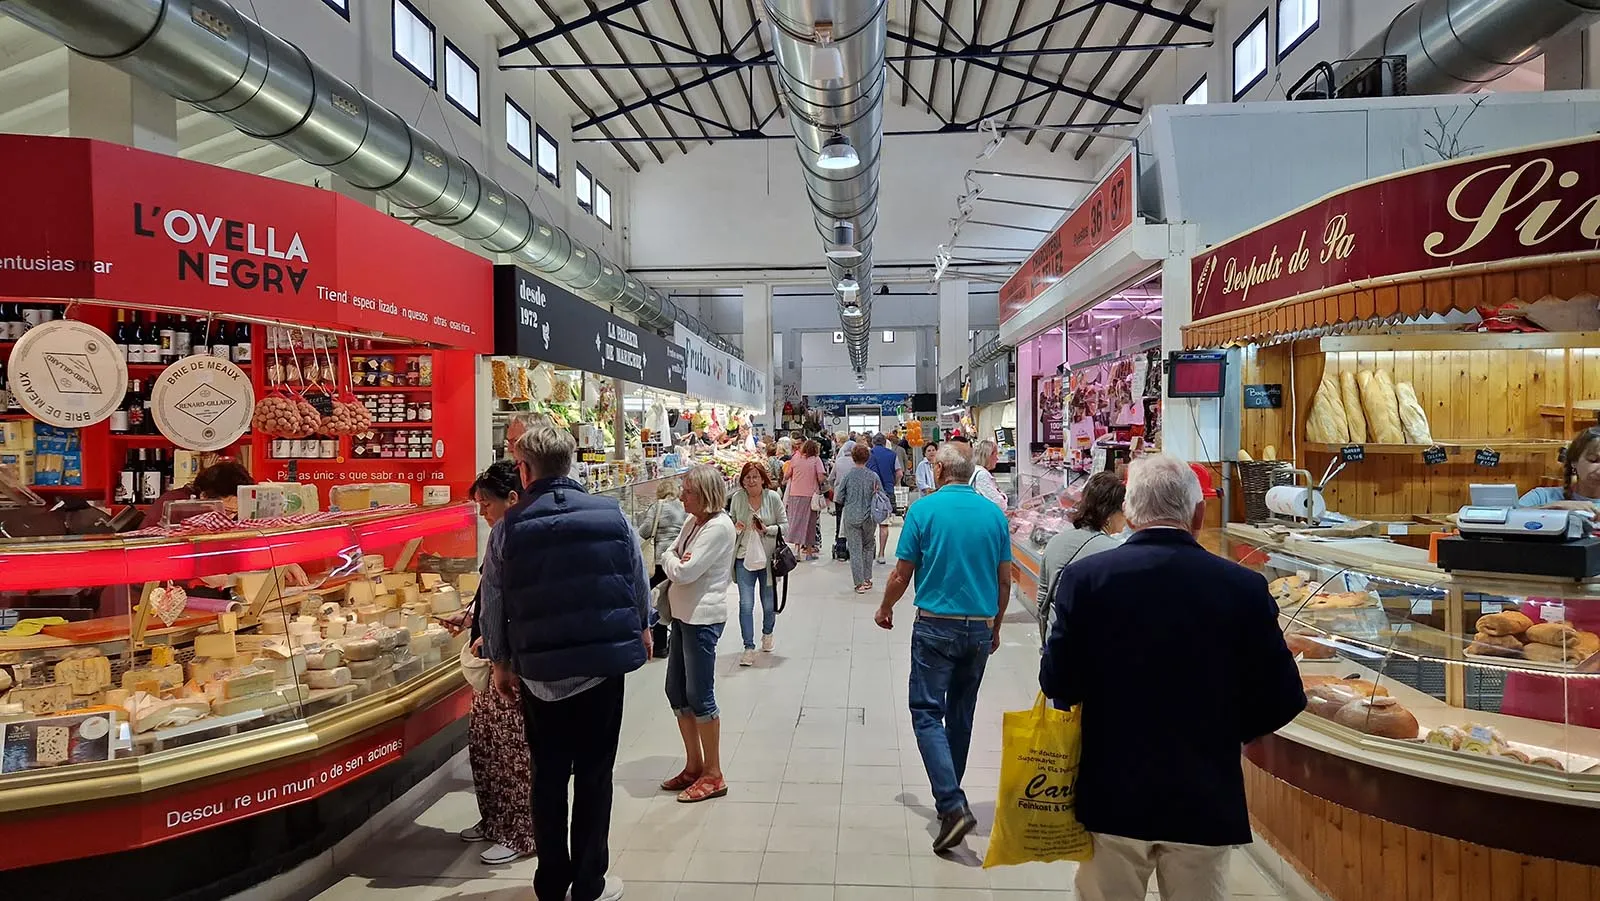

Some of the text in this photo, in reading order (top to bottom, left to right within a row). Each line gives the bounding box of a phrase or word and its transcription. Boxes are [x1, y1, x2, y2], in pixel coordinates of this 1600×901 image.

[1090, 199, 1103, 238] 36
[1111, 178, 1124, 221] 37
[134, 202, 309, 264] L'OVELLA
[1222, 212, 1355, 302] Despatx de Pa
[519, 279, 547, 308] desde
[520, 307, 538, 329] 1972
[607, 321, 616, 340] LA
[605, 343, 615, 361] DE
[166, 361, 241, 385] BRIE DE MEAUX
[19, 372, 91, 422] BRIE DE MEAUX
[179, 400, 233, 409] RENARD-GILLARD
[348, 471, 367, 481] que
[257, 786, 277, 803] un
[330, 762, 343, 779] de
[1018, 800, 1052, 812] Feinkost
